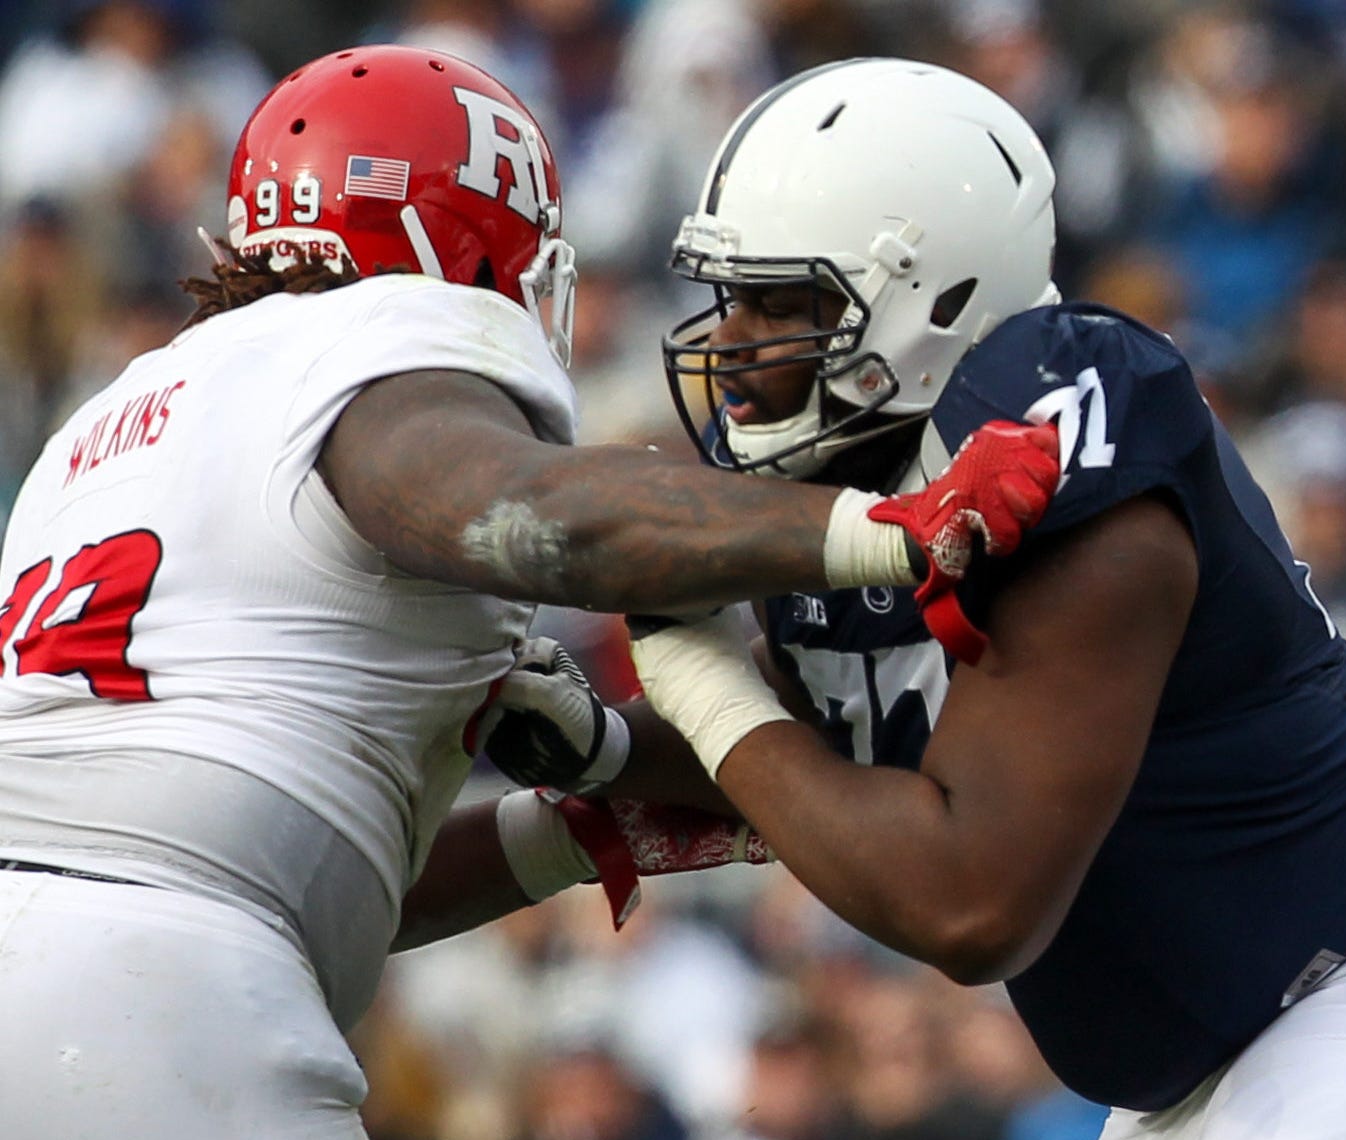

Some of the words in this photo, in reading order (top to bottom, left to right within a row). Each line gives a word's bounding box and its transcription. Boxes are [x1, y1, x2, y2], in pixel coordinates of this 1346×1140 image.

[256, 175, 321, 227] 99
[452, 86, 541, 225] R
[63, 379, 186, 490] WILKINS
